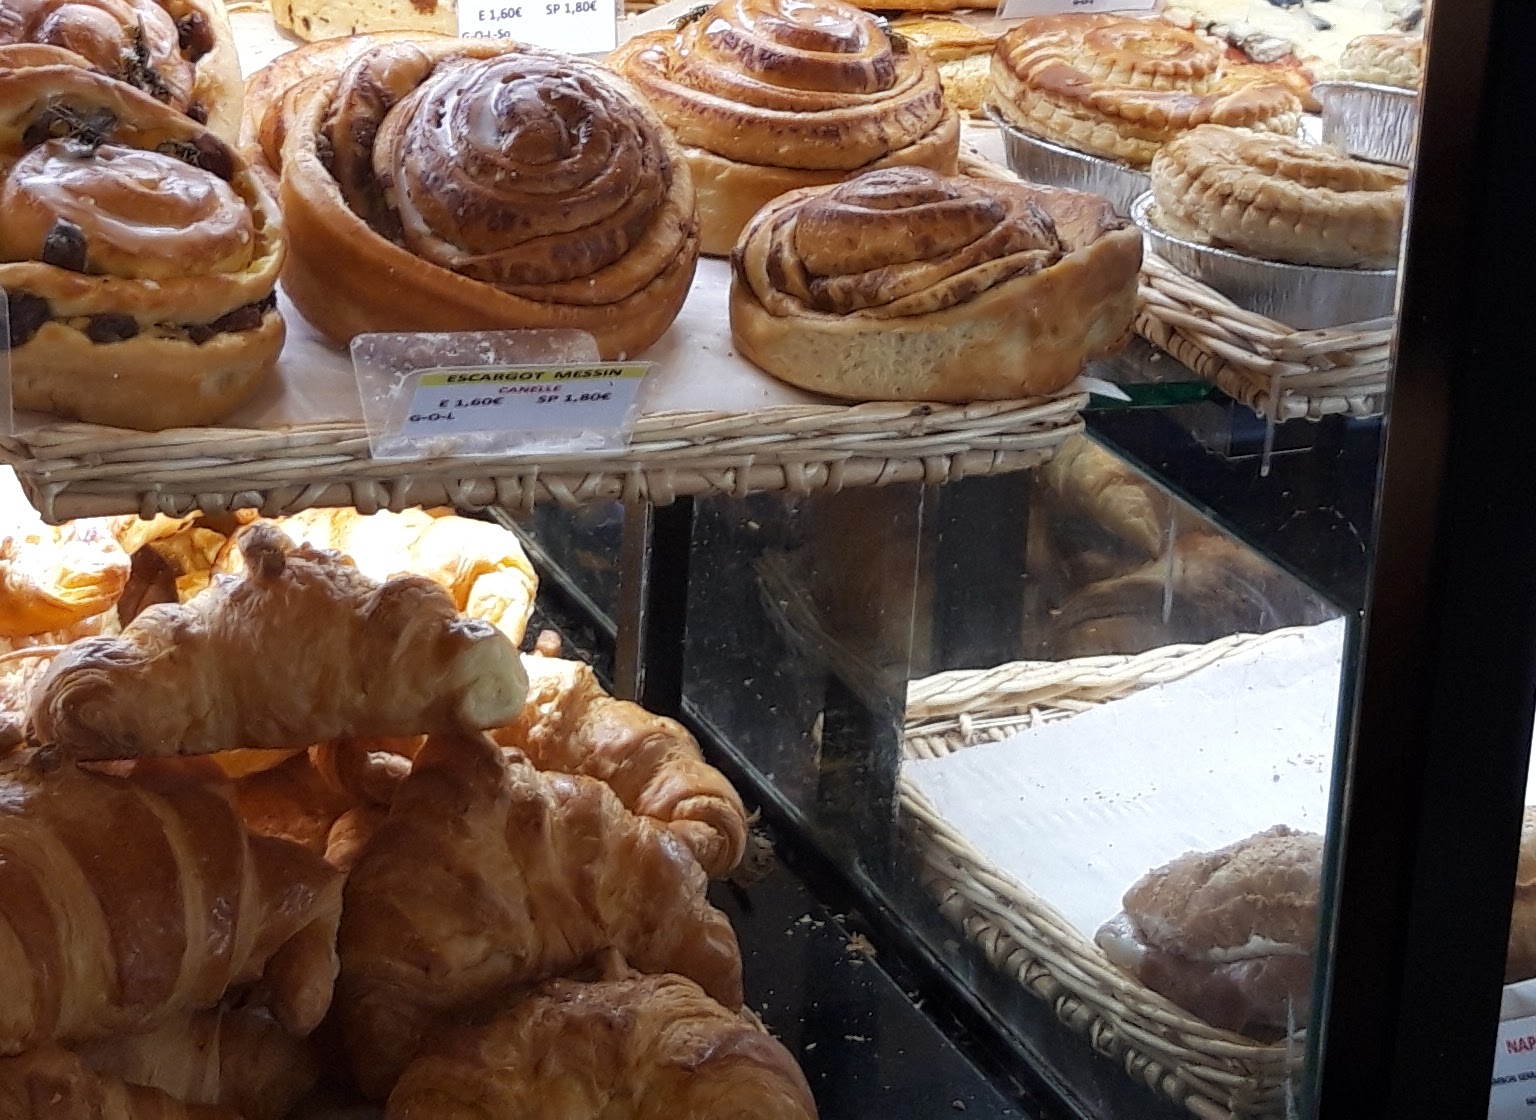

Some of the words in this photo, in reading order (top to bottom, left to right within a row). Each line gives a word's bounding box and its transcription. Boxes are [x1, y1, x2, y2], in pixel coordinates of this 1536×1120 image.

[478, 10, 485, 21] E
[489, 7, 522, 22] 1,60€
[546, 4, 560, 15] SP
[565, 0, 597, 15] 1,80€
[447, 371, 545, 383] ESCARGOT
[554, 368, 623, 379] MESSIN
[498, 385, 562, 394] CANELLE
[439, 399, 449, 408] E
[535, 395, 559, 404] SP
